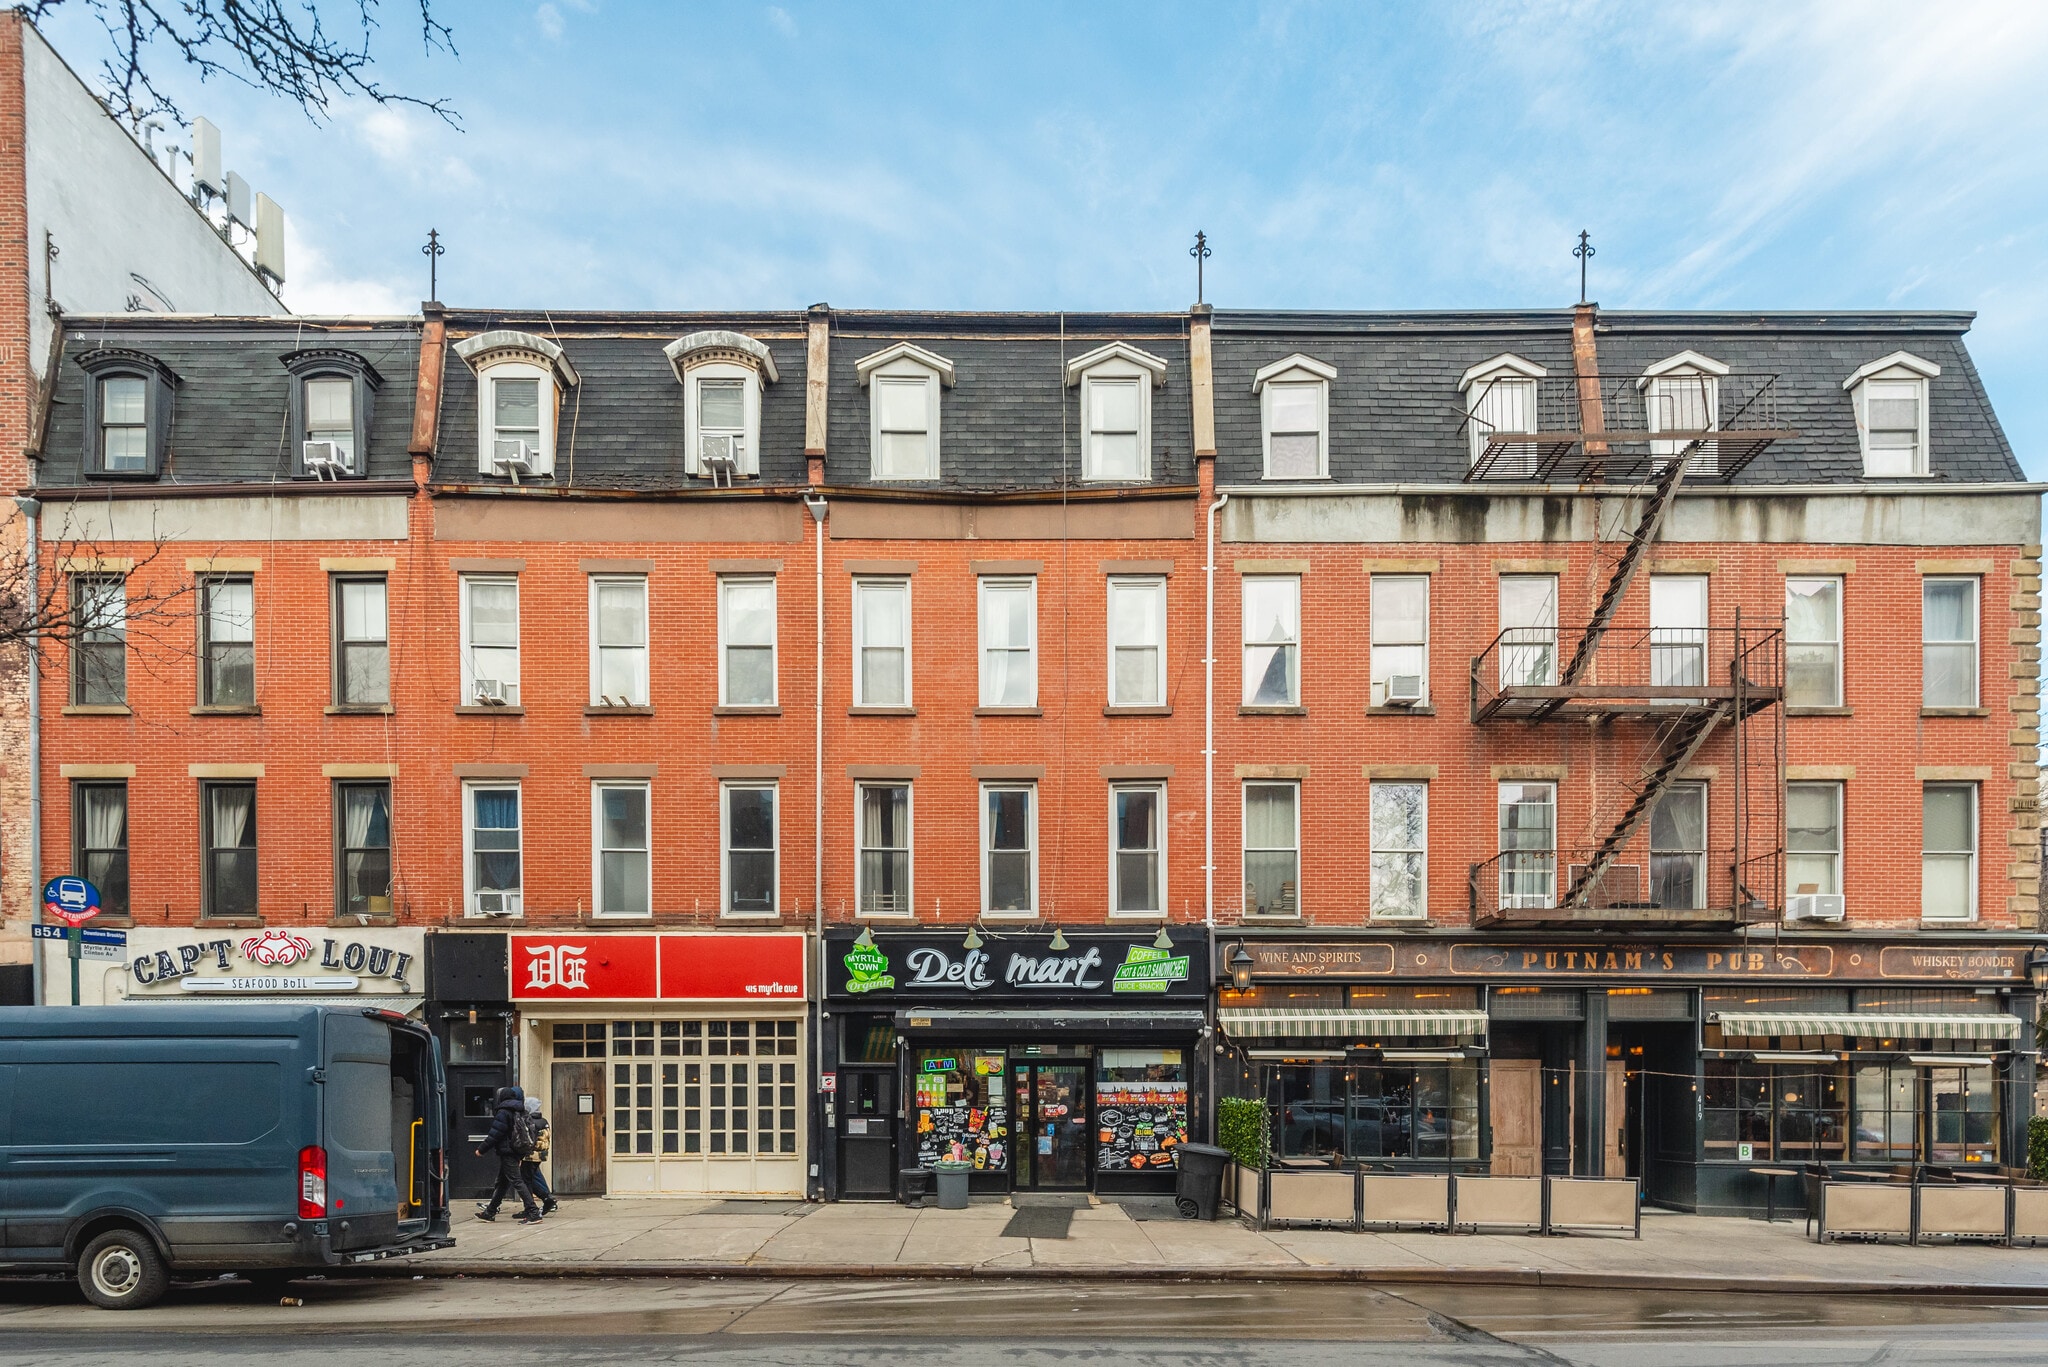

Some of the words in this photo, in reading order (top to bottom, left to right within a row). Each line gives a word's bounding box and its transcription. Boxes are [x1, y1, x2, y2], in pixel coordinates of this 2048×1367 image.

[51, 905, 61, 914] NO
[62, 909, 97, 920] STANDING
[34, 926, 62, 938] B54
[133, 938, 233, 985] CAP'T
[320, 938, 411, 982] LOUI
[847, 954, 883, 964] MYRTLE
[1130, 950, 1163, 961] COFFEE
[1259, 952, 1289, 963] WINE
[1292, 952, 1316, 963] AND
[1319, 952, 1361, 963] SPIRITS
[1522, 952, 1674, 971] PUTNAM'S
[1706, 952, 1764, 971] PUB
[1912, 955, 1965, 967] WHISKEY
[1968, 956, 2015, 967] BONDER
[853, 962, 879, 971] TOWN
[905, 947, 991, 990] Deli
[1004, 946, 1102, 987] mart
[1121, 967, 1131, 978] HOT
[1131, 967, 1137, 977] &
[1137, 965, 1151, 976] COLD
[1152, 960, 1187, 977] SANDWICHES
[231, 978, 278, 989] SEAFOOD
[283, 978, 308, 989] BOIL
[758, 981, 783, 996] myrtle
[783, 984, 798, 993] ave
[848, 978, 893, 991] Organic
[1115, 982, 1135, 990] JUICE
[1138, 982, 1165, 990] SNACKS
[928, 1060, 953, 1070] ATM
[1741, 1146, 1750, 1156] B
